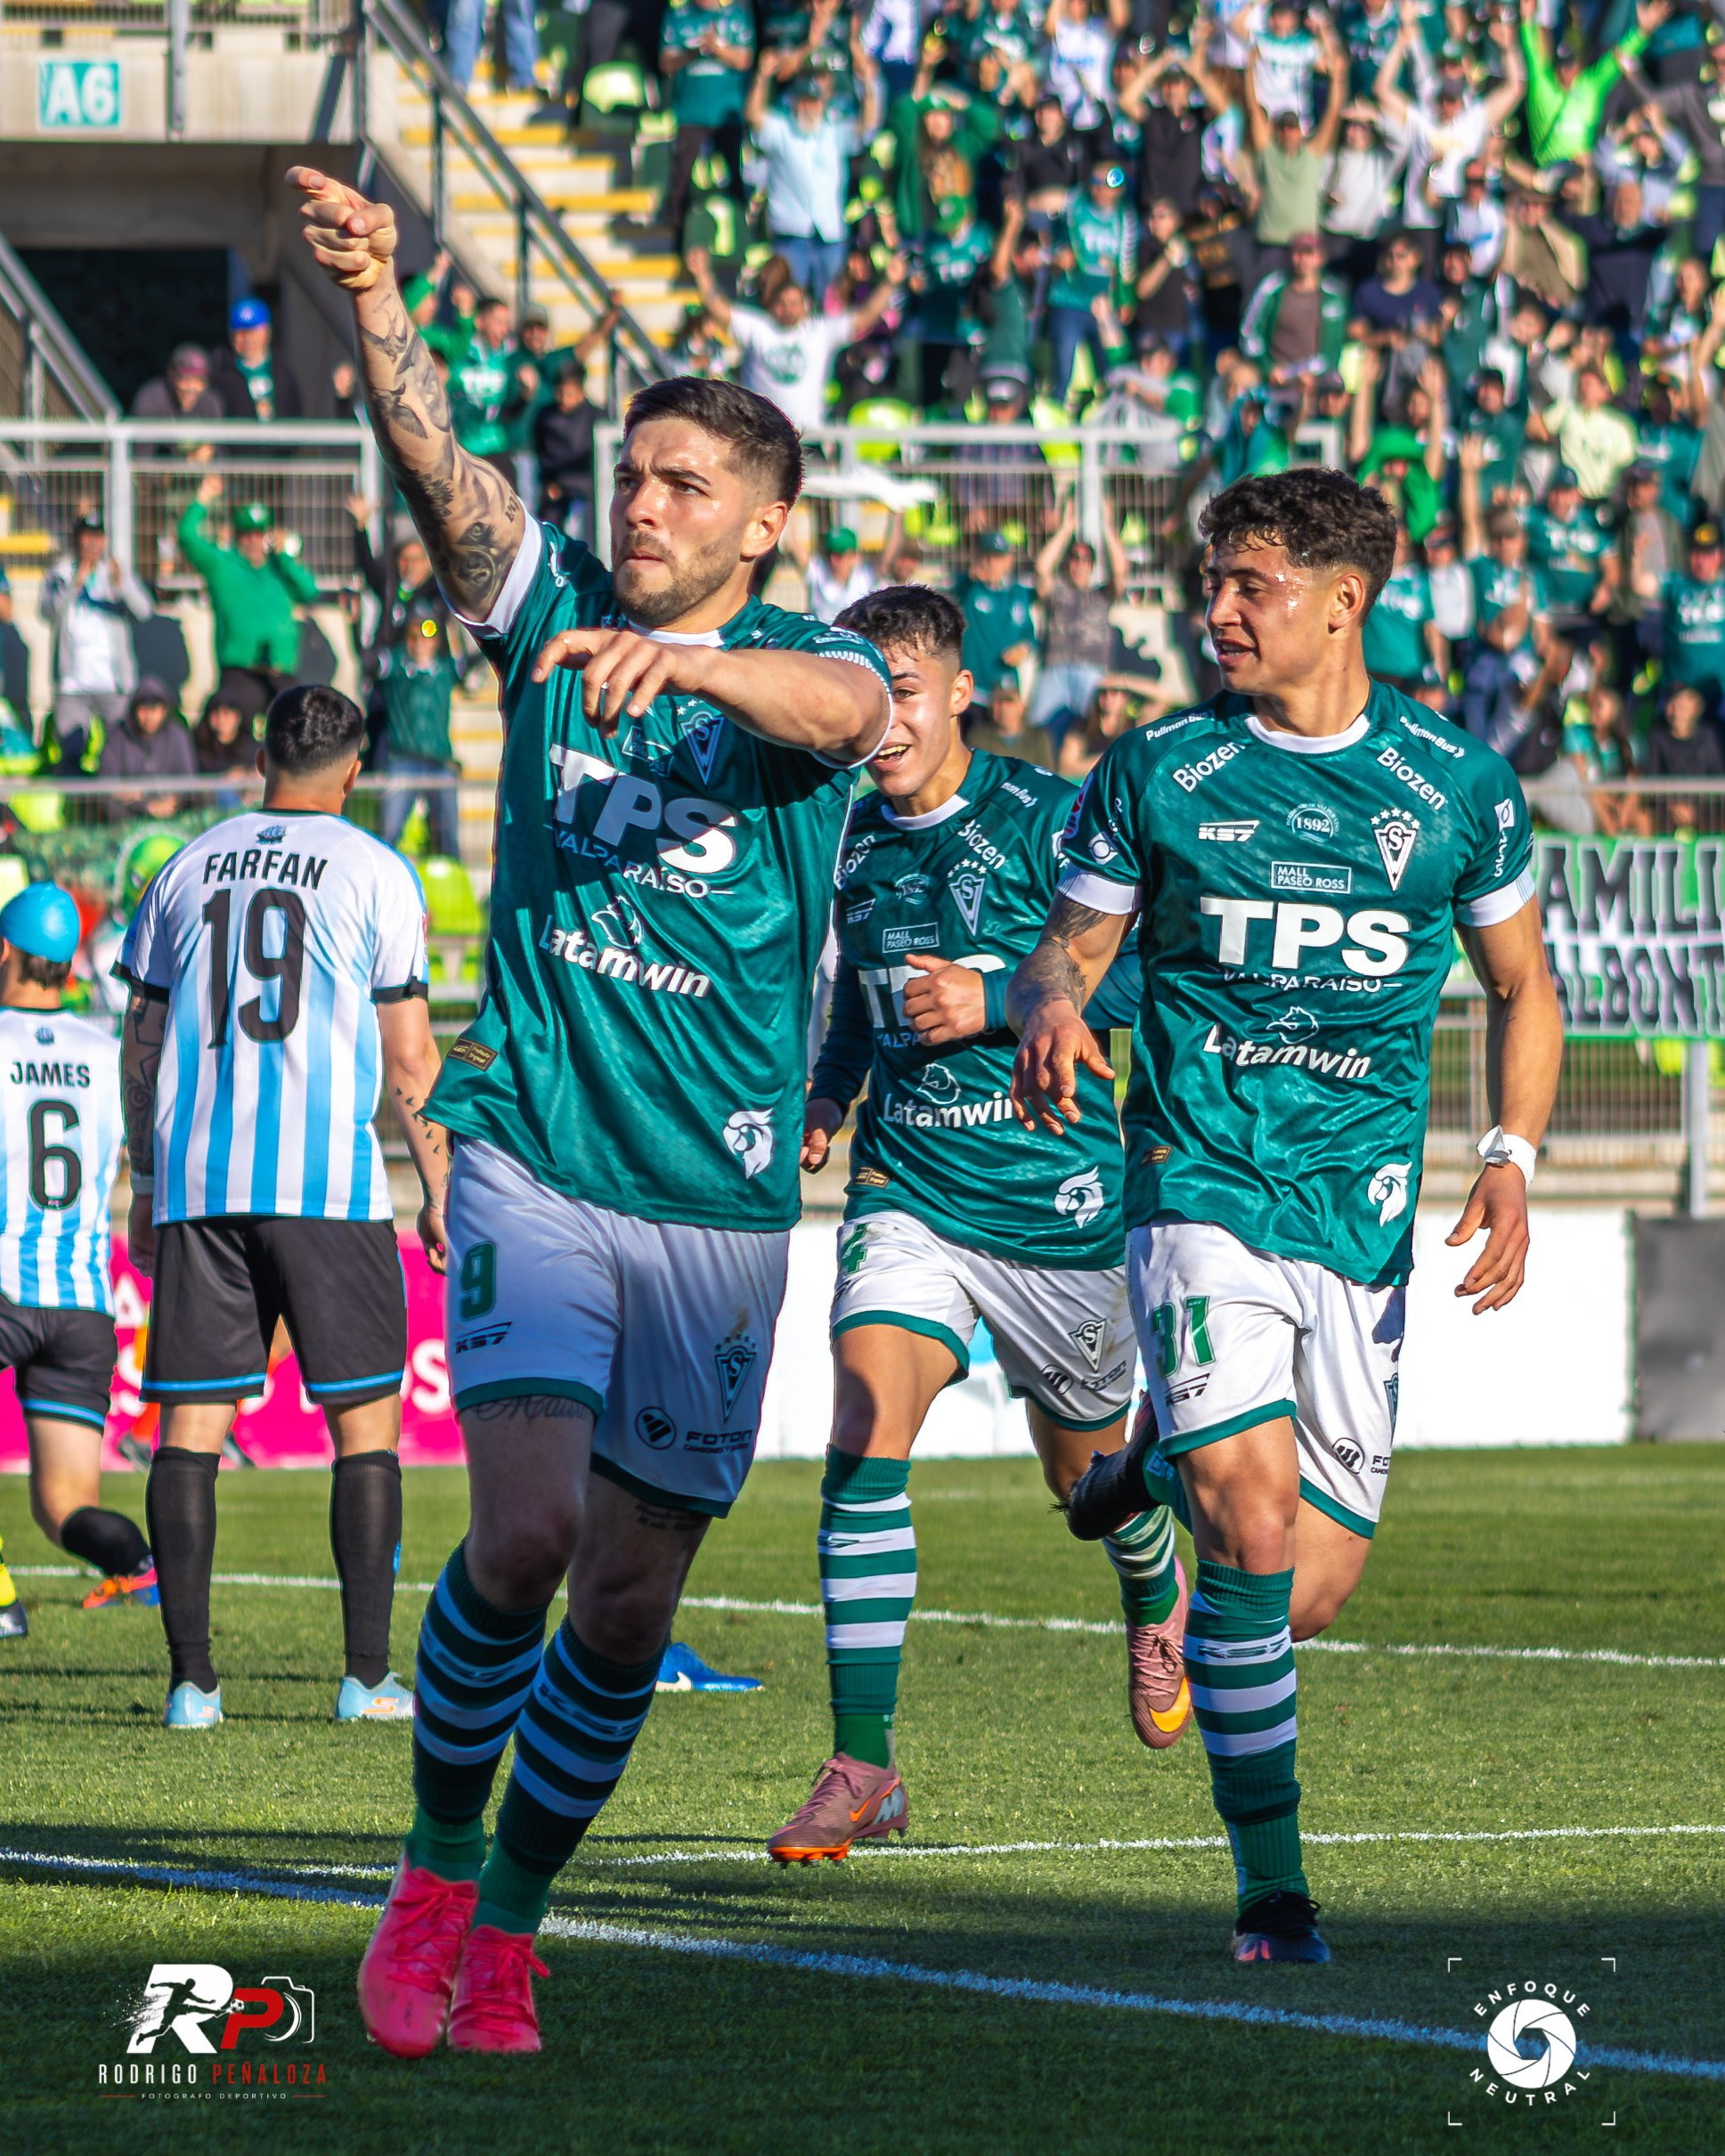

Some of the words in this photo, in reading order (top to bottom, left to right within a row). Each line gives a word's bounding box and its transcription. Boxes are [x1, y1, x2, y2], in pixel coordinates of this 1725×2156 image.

[46, 64, 116, 124] A6
[1172, 741, 1247, 793] Biozen
[1377, 746, 1446, 810] Biozen
[549, 743, 736, 875] TPS
[1297, 817, 1330, 833] 1892
[202, 849, 328, 891] FARFAN
[1277, 866, 1309, 877] MALL
[1277, 875, 1313, 887] PASEO
[1200, 896, 1412, 977] TPS
[202, 886, 307, 1049] 19
[10, 1060, 91, 1088] JAMES
[1202, 1023, 1371, 1079] Latamwin
[27, 1097, 82, 1211] 6
[459, 1240, 497, 1321] 9
[1151, 1296, 1216, 1380] 31
